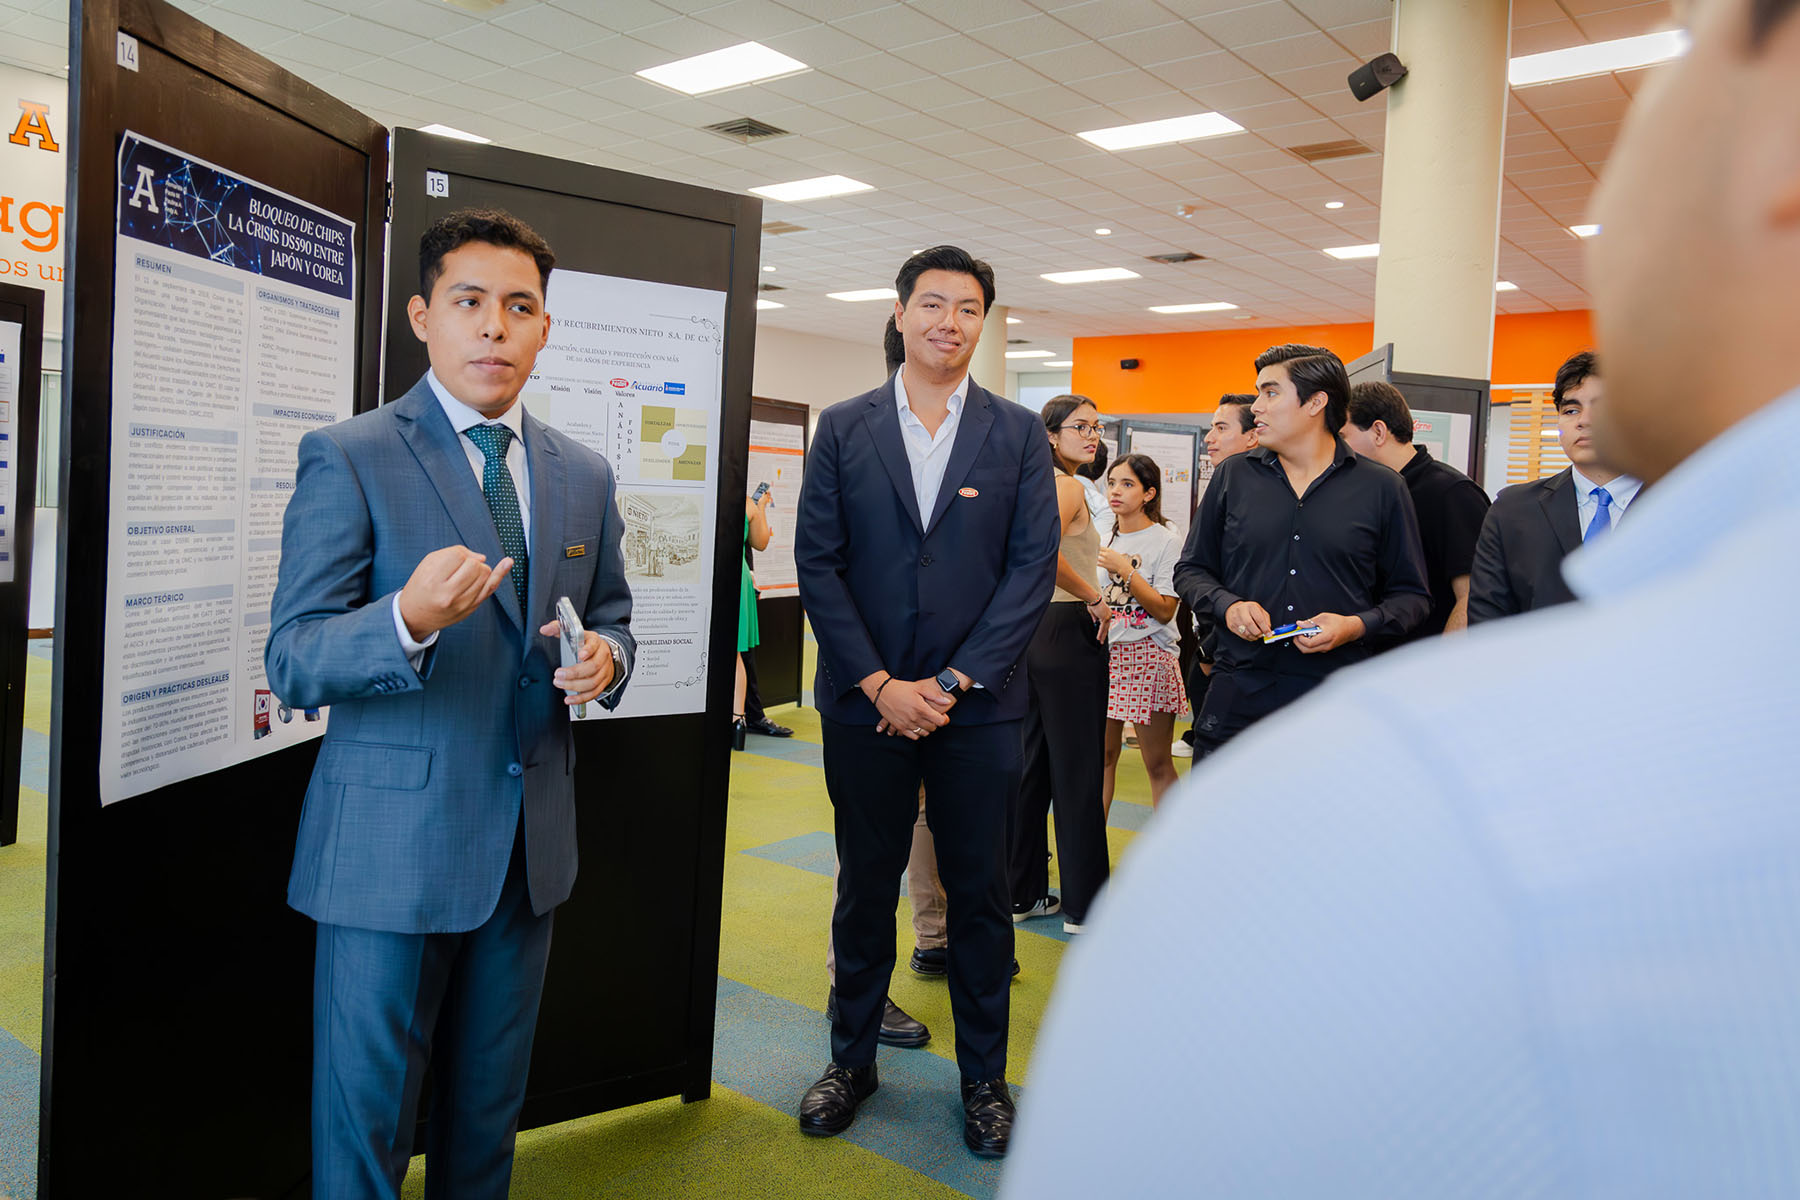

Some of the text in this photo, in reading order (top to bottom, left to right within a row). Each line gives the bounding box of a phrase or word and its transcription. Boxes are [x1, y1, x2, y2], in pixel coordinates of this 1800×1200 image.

[121, 42, 134, 64] 14
[9, 99, 59, 152] A
[128, 164, 159, 213] A
[430, 178, 444, 192] 15
[250, 198, 345, 247] BLOQUEO DE CHIPS:
[229, 213, 344, 266] LA CRISIS DS590 ENTRE
[137, 258, 172, 273] RESUMEN
[271, 249, 344, 285] JAPÓN Y COREA
[259, 291, 294, 305] ORGANISMOS
[300, 302, 324, 314] TRATADOS
[325, 309, 340, 318] CLAVE
[564, 320, 637, 334] RECUBRIMIENTOS
[639, 328, 664, 337] NIETO
[685, 334, 695, 342] DE
[580, 347, 607, 355] CALIDAD
[613, 350, 651, 360] PROTECCIÓN
[611, 360, 651, 368] EXPERIENCIA
[550, 384, 571, 392] Misión
[632, 381, 663, 392] Acuario
[273, 409, 335, 422] IMPACTOS ECONÓMICOS
[131, 428, 185, 439] JUSTIFICACIÓN
[127, 525, 195, 535] OBJETIVO GENERAL
[126, 593, 184, 607] MARCO TEÓRICO
[123, 691, 150, 703] ORIGEN
[159, 681, 195, 695] PRÁCTICAS
[197, 673, 229, 687] DESLEALES
